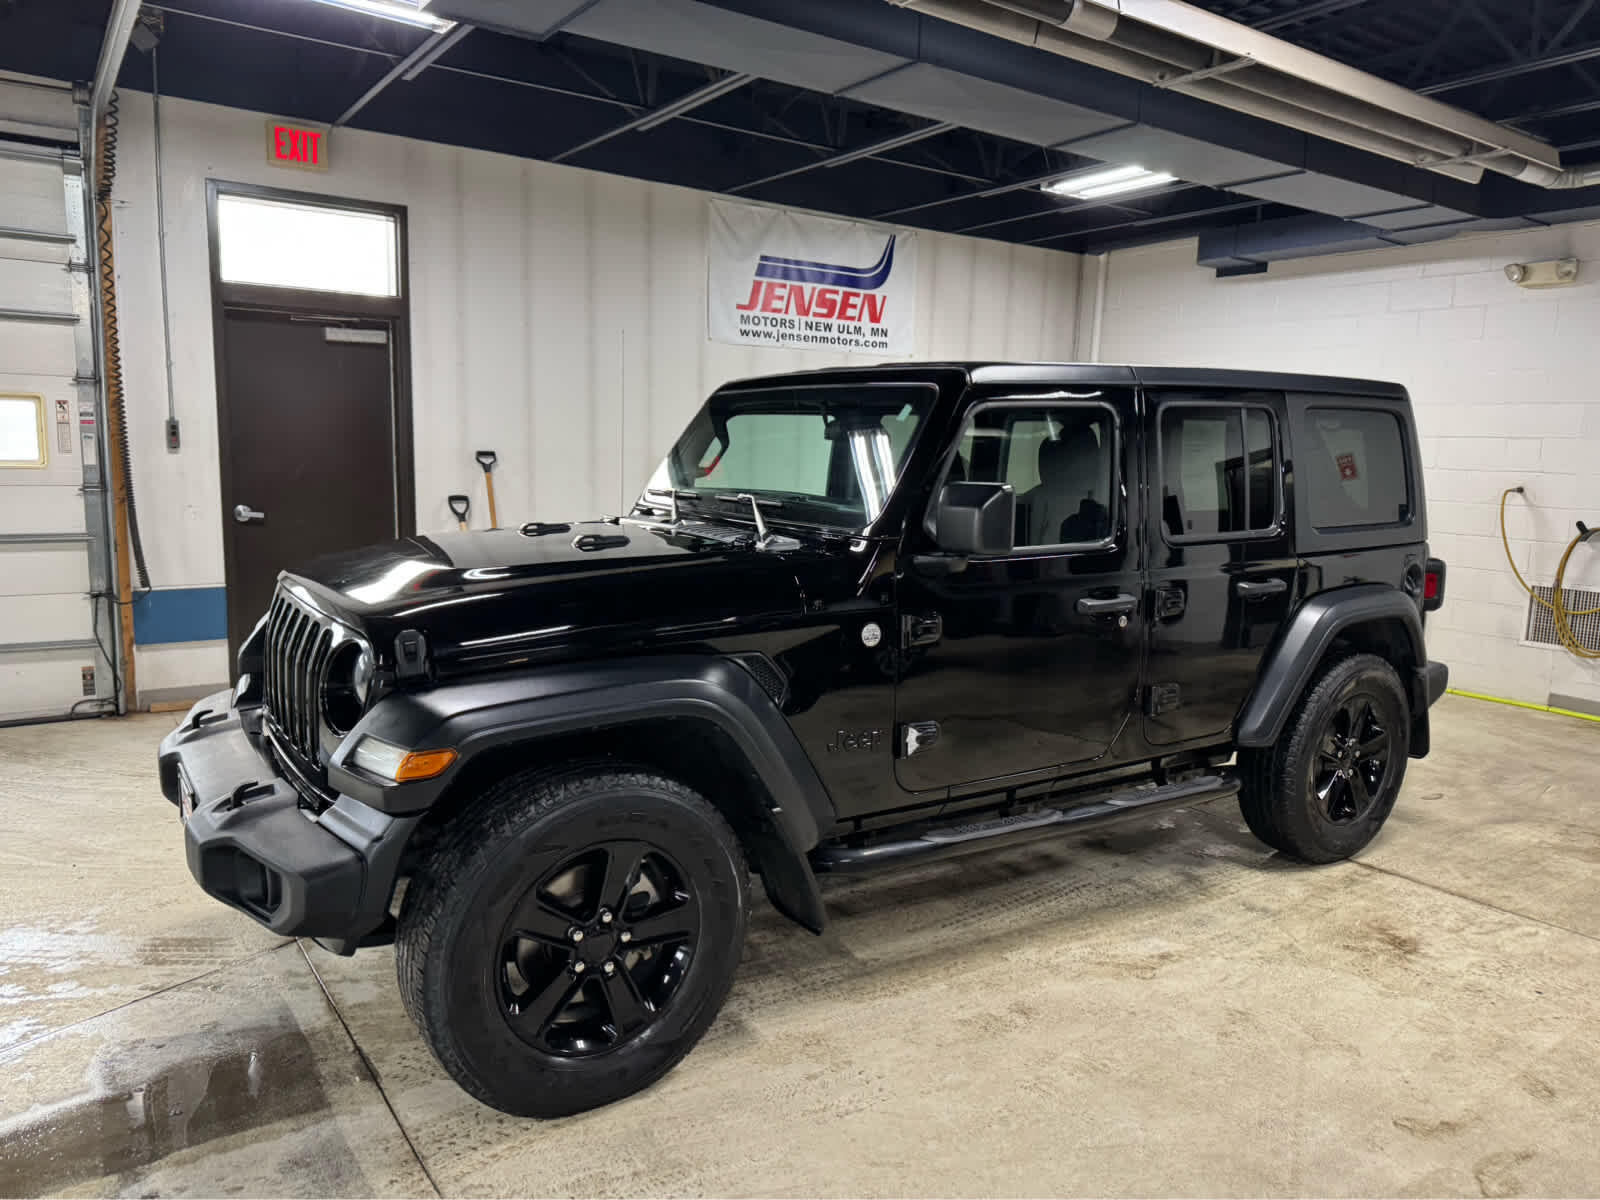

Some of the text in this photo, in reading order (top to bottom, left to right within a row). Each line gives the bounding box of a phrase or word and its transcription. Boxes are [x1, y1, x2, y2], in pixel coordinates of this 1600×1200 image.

[274, 126, 321, 164] EXIT
[736, 280, 887, 324] JENSEN
[740, 314, 888, 338] MOTORS NEW ULM, MN
[740, 328, 888, 349] www.jensenmotors.com
